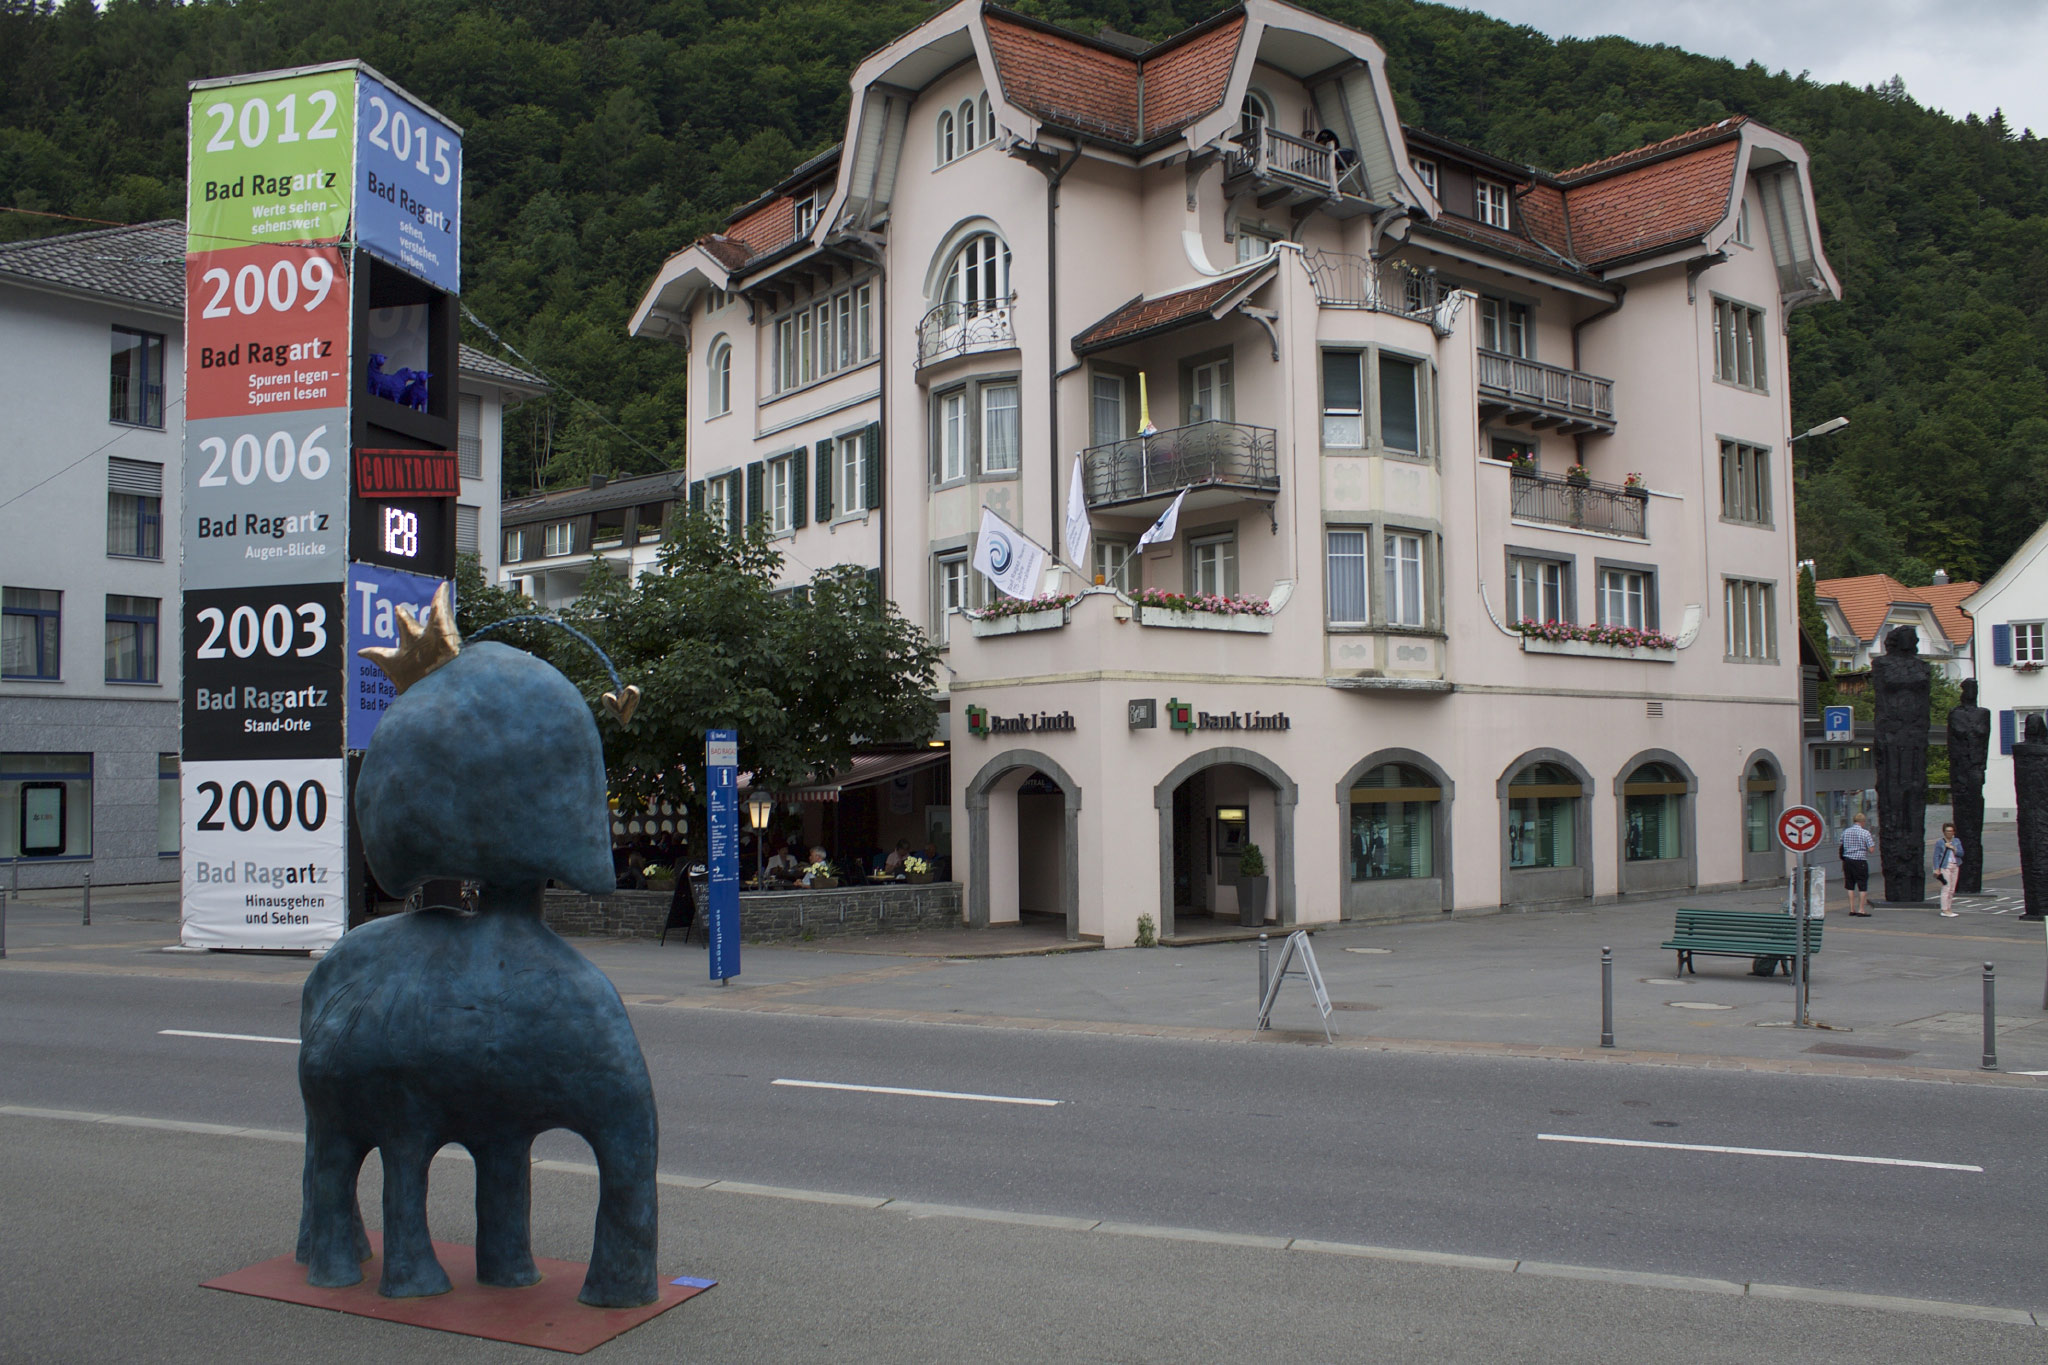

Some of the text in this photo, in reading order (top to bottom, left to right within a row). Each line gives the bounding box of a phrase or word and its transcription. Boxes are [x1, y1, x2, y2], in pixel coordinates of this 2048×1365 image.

[206, 90, 338, 152] 2012
[369, 96, 451, 186] 2015
[205, 169, 336, 202] Bad Ragartz
[252, 204, 286, 218] Werte
[289, 200, 326, 213] sehen
[368, 171, 451, 234] Bad Ragartz
[251, 216, 320, 235] sehenswert
[400, 221, 425, 243] sehen,
[400, 236, 439, 267] verstehen,
[400, 249, 426, 273] lieben.
[202, 256, 334, 319] 2009
[201, 337, 332, 369] Bad Ragartz
[248, 374, 291, 390] Spuren
[294, 370, 328, 385] legen
[248, 387, 327, 406] Spuren lesen
[199, 425, 331, 488] 2006
[362, 456, 455, 490] COUNTDOWN
[198, 511, 329, 539] Bad Ragartz
[385, 507, 418, 557] 128
[245, 541, 326, 561] Augen-Blicke
[196, 602, 328, 660] 2003
[197, 684, 328, 714] Bad Ragartz
[360, 680, 376, 694] Bad
[360, 698, 376, 711] Bad
[244, 718, 311, 733] Stand-Orte
[990, 711, 1076, 732] Bank Linth
[1198, 711, 1291, 730] Bank Linth
[1834, 716, 1842, 728] P
[197, 779, 328, 832] 2000
[197, 861, 328, 889] Bad Ragartz
[245, 894, 325, 910] Hinausgehen
[246, 911, 309, 925] und Sehen
